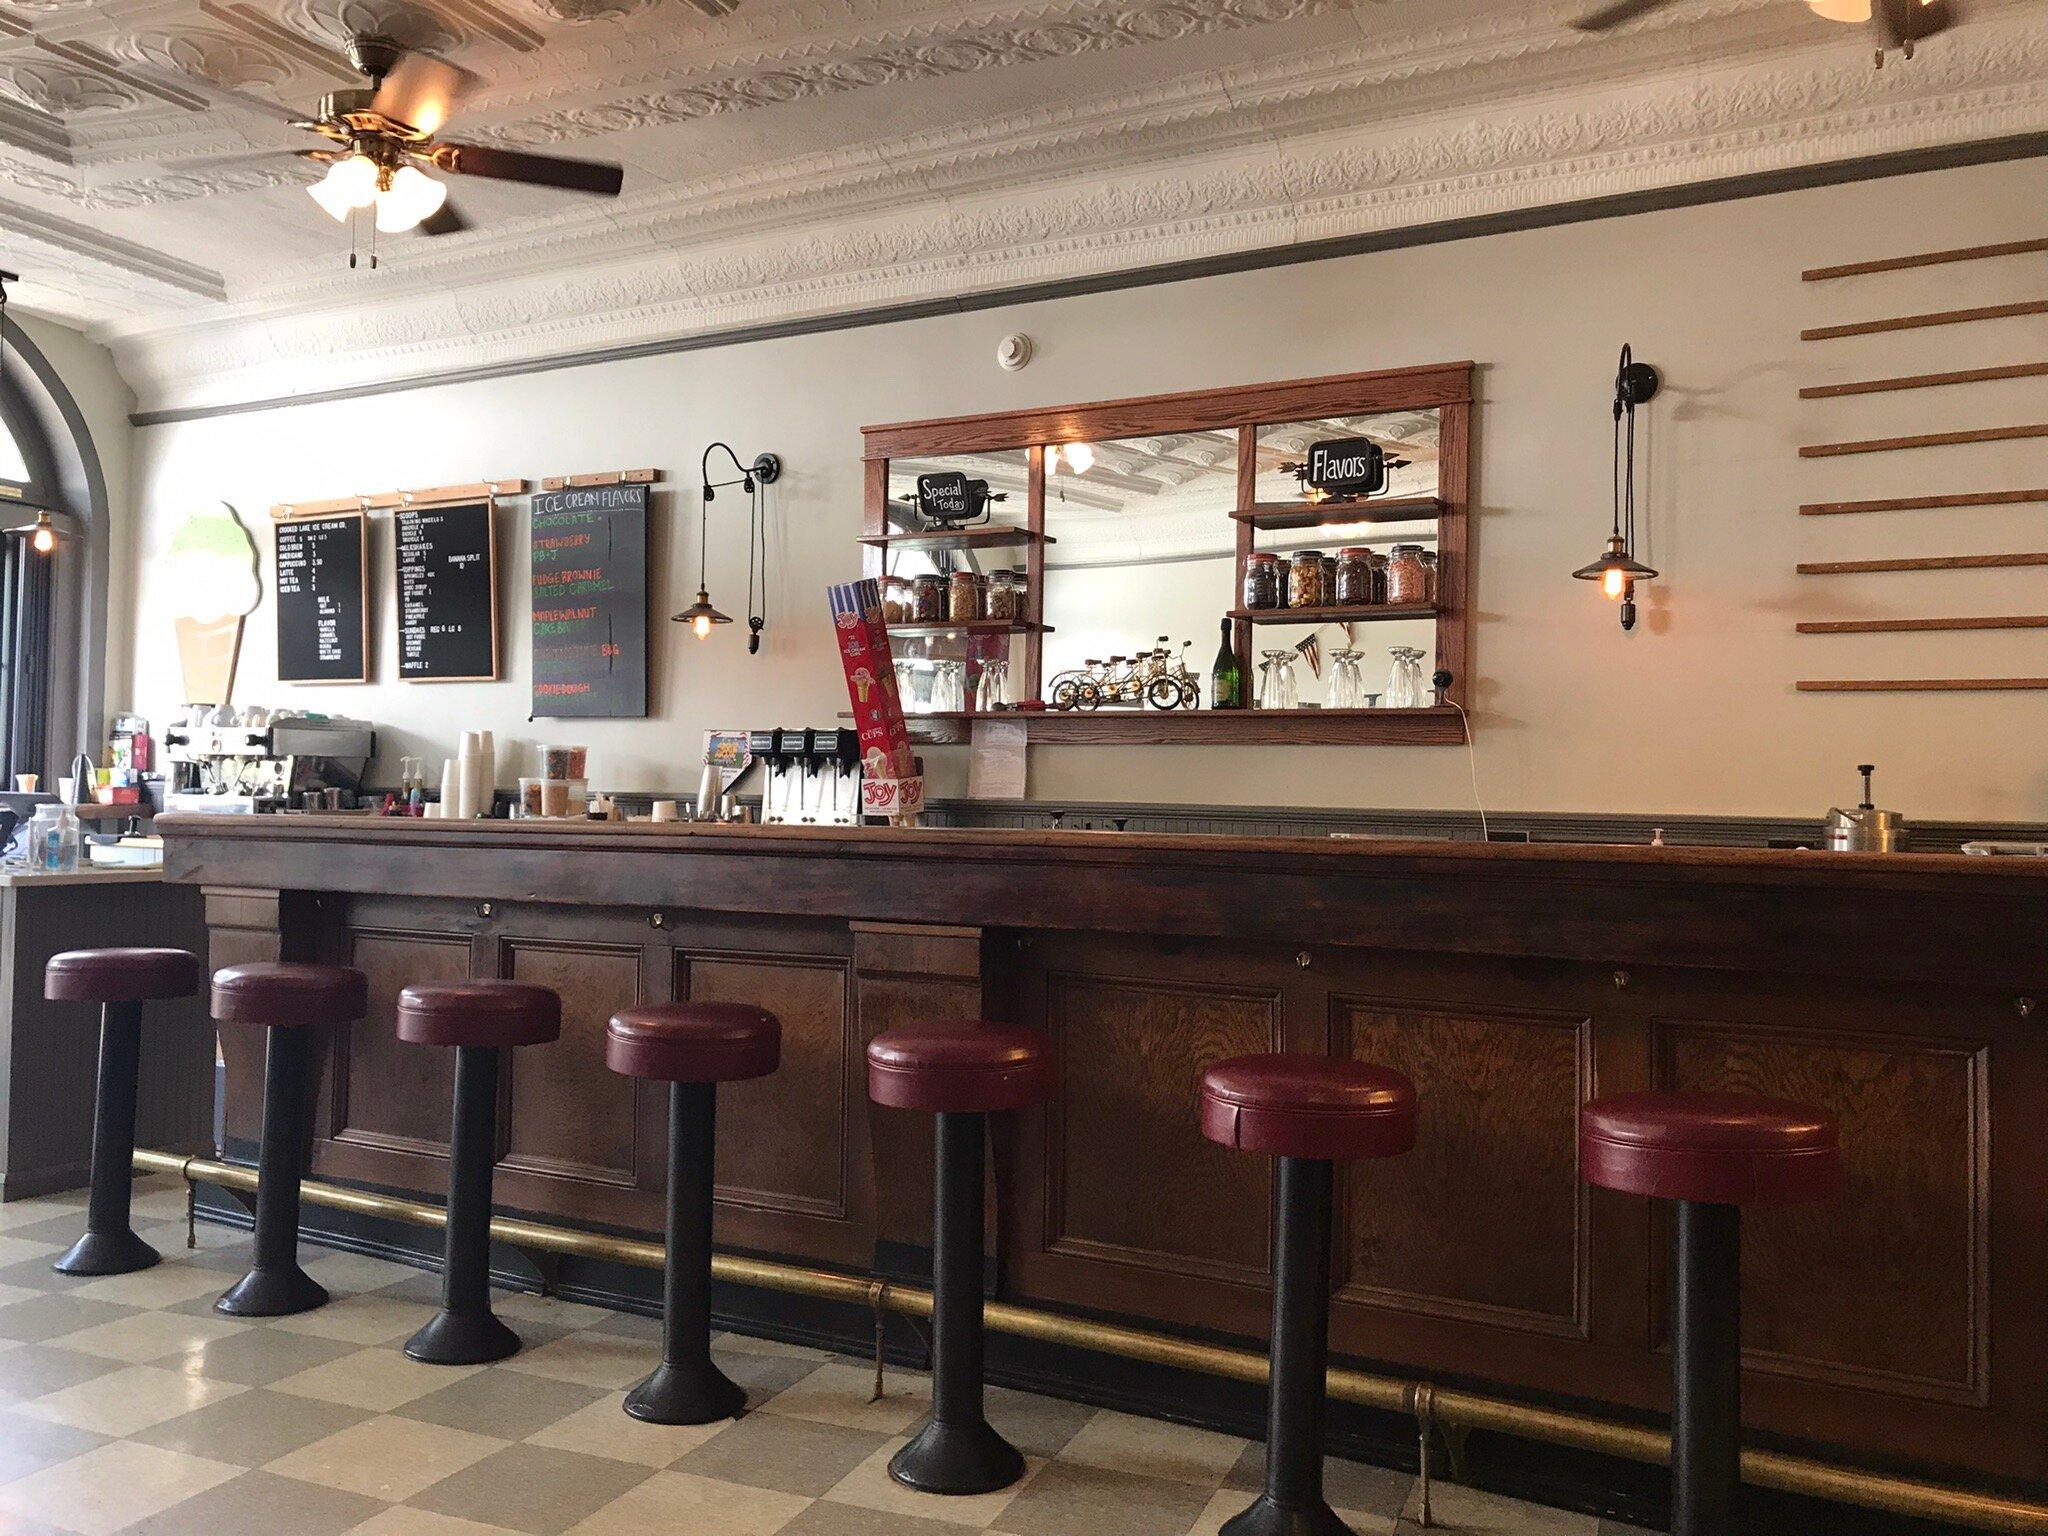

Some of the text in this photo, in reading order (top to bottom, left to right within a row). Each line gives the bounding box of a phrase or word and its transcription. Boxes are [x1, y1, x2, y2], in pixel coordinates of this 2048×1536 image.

[1313, 450, 1365, 481] Flavors
[923, 479, 962, 506] Special
[534, 489, 641, 515] ICE CREAM FLAVORS
[937, 498, 964, 510] Today
[322, 522, 338, 530] CREAM
[533, 513, 594, 529] CHOCOLATE
[533, 534, 590, 549] STRAWBERRY
[279, 560, 306, 568] CAPPUCCINO
[562, 567, 602, 584] BROWNIE
[533, 607, 597, 621] MAPLE WALNUT
[862, 729, 883, 740] CUPS
